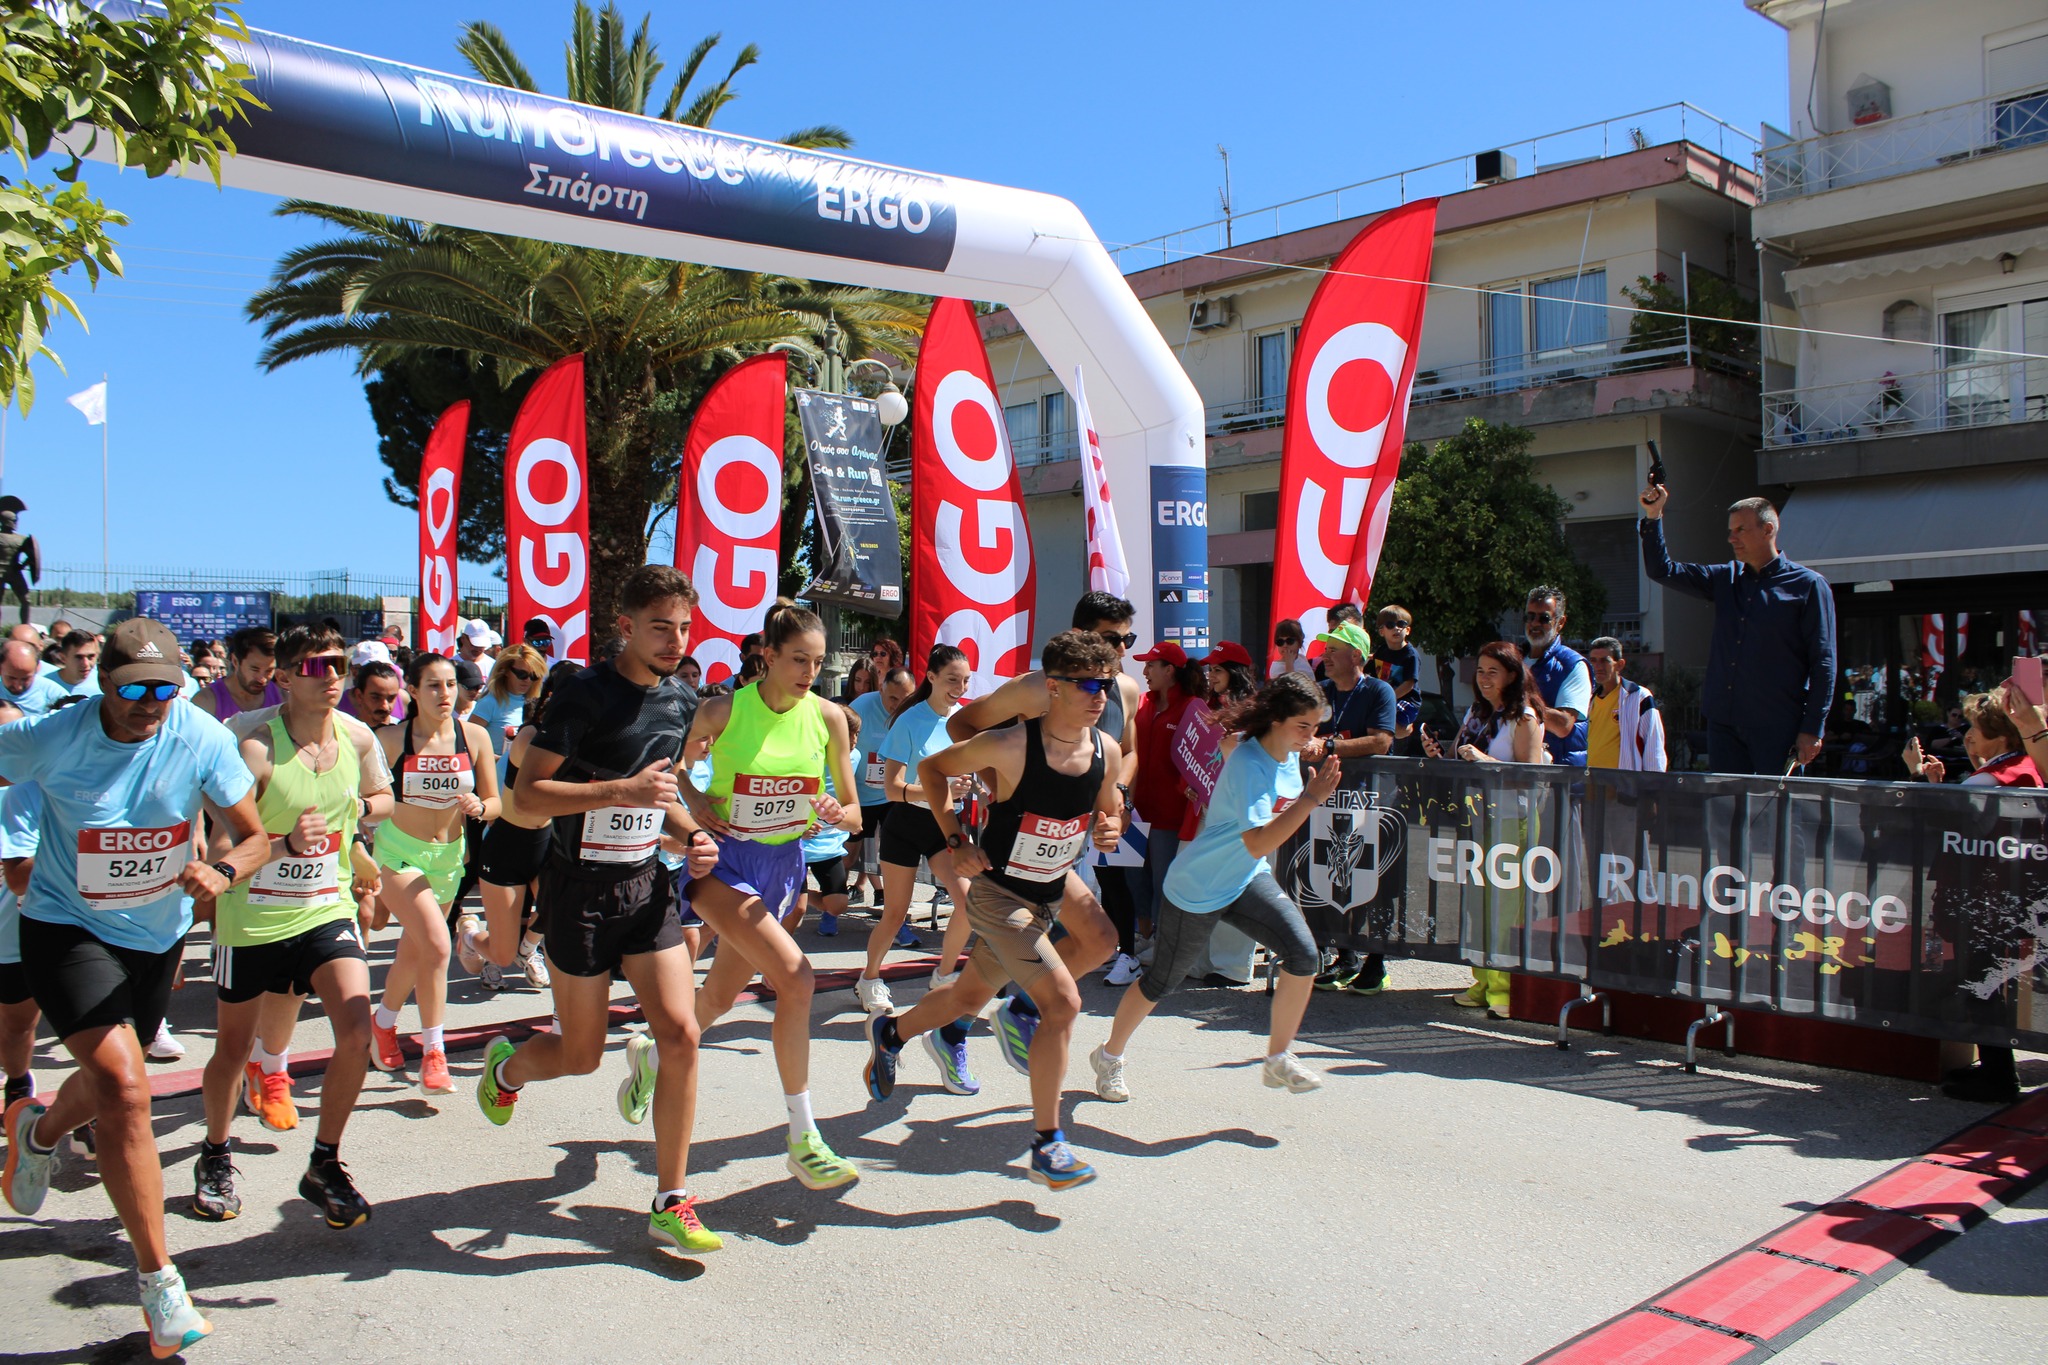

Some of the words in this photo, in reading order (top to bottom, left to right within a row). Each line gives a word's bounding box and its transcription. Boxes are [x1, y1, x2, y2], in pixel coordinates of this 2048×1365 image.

[416, 75, 744, 187] RunGreece
[523, 164, 649, 220] Σπάρτη
[817, 177, 932, 235] ERGO
[836, 467, 845, 478] &
[847, 466, 868, 479] Run
[831, 493, 880, 506] .run-greece.gr
[932, 370, 1030, 700] RGO
[171, 597, 202, 607] ERGO
[882, 589, 898, 597] ERGO
[1185, 722, 1200, 750] Μη
[417, 757, 460, 771] ERGO
[1177, 738, 1215, 796] Σταματάς
[422, 777, 460, 790] 5040
[749, 778, 804, 794] ERGO
[74, 790, 110, 802] ERGO
[1322, 789, 1380, 810] ΕΓΑΣ
[753, 799, 796, 816] 5079
[588, 815, 596, 834] Block
[610, 813, 653, 831] 5015
[1035, 819, 1080, 838] ERGO
[99, 830, 173, 851] ERGO
[303, 837, 330, 855] GO
[1942, 830, 2048, 861] RunGre
[109, 856, 167, 878] 5247
[277, 863, 324, 879] 5022
[1427, 837, 1561, 894] ERGO
[1598, 853, 1908, 933] RunGreece
